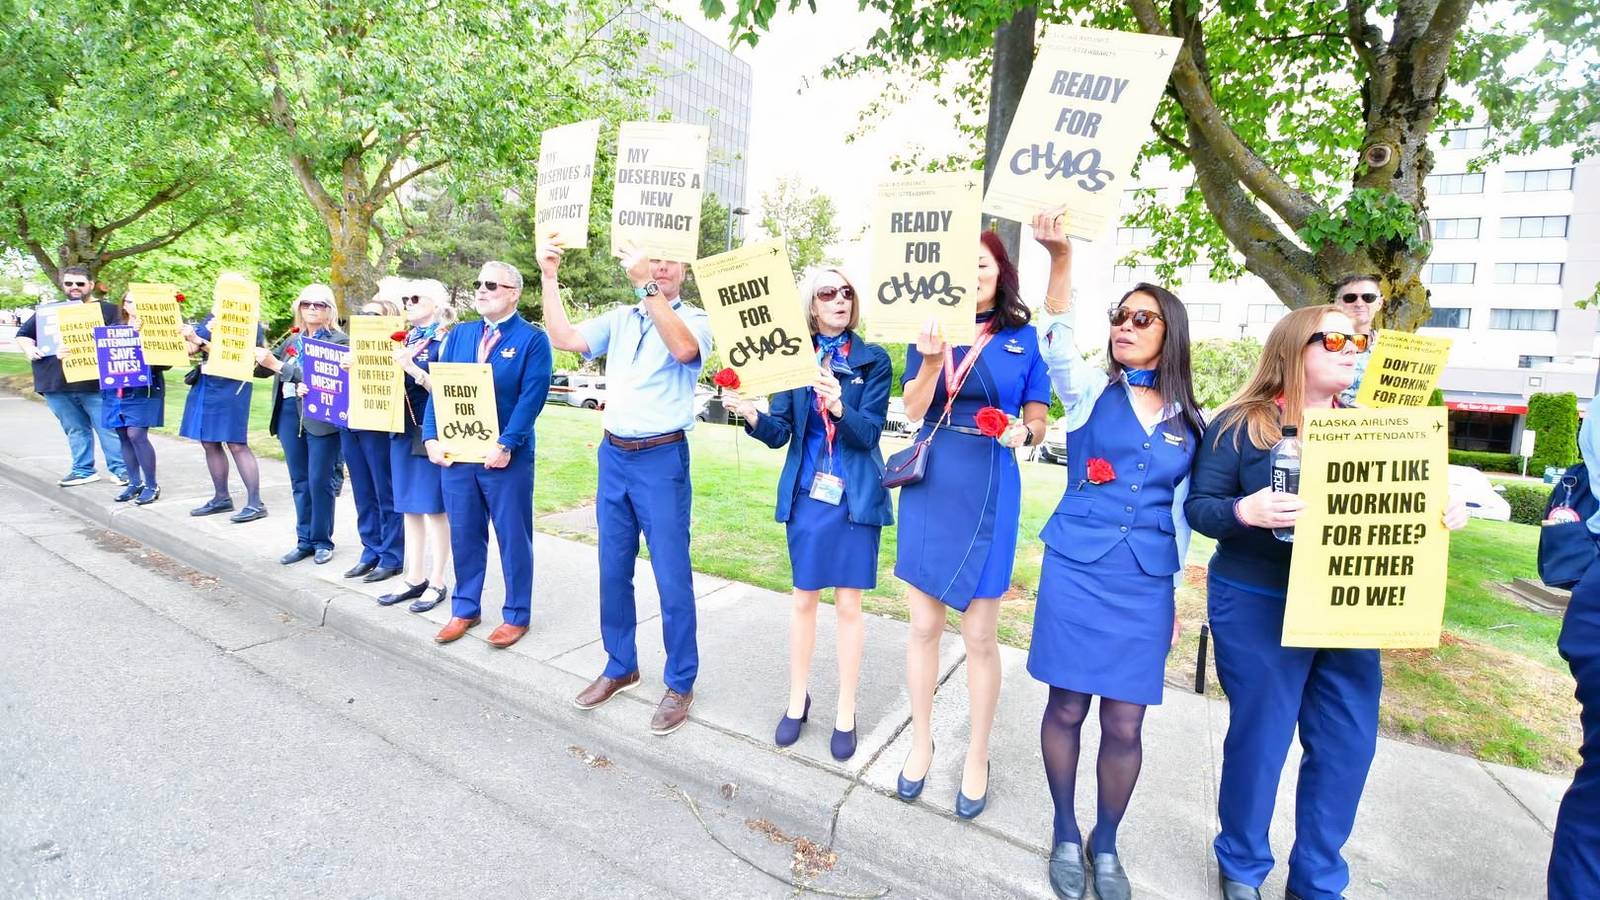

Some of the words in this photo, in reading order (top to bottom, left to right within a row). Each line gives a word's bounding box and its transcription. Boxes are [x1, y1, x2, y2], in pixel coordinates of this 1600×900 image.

[1049, 70, 1129, 103] READY
[1055, 108, 1102, 138] FOR
[545, 152, 557, 164] MY
[628, 148, 648, 163] MY
[539, 165, 580, 186] DESERVES
[584, 164, 590, 178] A
[1010, 142, 1115, 192] CHAOS
[618, 169, 686, 188] DESERVES
[691, 174, 700, 189] A
[550, 186, 569, 200] NEW
[640, 190, 672, 207] NEW
[538, 204, 583, 224] CONTRACT
[618, 210, 692, 232] CONTRACT
[891, 210, 952, 233] READY
[905, 242, 941, 263] FOR
[718, 276, 769, 306] READY
[878, 271, 966, 306] CHAOS
[140, 315, 175, 324] STALLING
[739, 305, 772, 328] FOR
[63, 333, 95, 344] STALLIN
[157, 329, 168, 337] PAY
[98, 337, 141, 348] ATTENDANT
[144, 341, 183, 350] APPALLING
[356, 340, 376, 350] DON'T
[377, 341, 393, 351] LIKE
[730, 328, 802, 367] CHAOS
[109, 348, 136, 360] SAVE
[305, 343, 345, 363] CORPORAT
[358, 356, 393, 366] WORKING
[66, 357, 98, 368] APPALL
[108, 360, 141, 373] LIVES!
[314, 360, 339, 377] GREED
[1383, 358, 1418, 373] DON'T
[1419, 363, 1437, 375] LIKE
[311, 374, 343, 392] DOESN'T
[358, 370, 371, 379] FOR
[372, 371, 394, 380] FREE?
[1380, 374, 1429, 391] WORKING
[362, 385, 391, 395] NEITHER
[443, 385, 477, 398] READY
[1373, 390, 1397, 403] FOR
[1398, 394, 1424, 406] FREE?
[320, 392, 334, 406] FLY
[364, 399, 374, 409] DO
[376, 400, 390, 410] WE!
[455, 403, 475, 415] FOR
[443, 420, 492, 440] CHAOS
[1310, 419, 1356, 427] ALASKA
[1361, 418, 1409, 427] AIRLINES
[1309, 433, 1350, 441] FLIGHT
[1354, 431, 1427, 441] ATTENDANTS
[1327, 461, 1386, 483] DON'T
[1392, 460, 1429, 482] LIKE
[1327, 492, 1426, 514] WORKING
[1322, 525, 1361, 545] FOR
[1367, 524, 1426, 545] FREE?
[1328, 556, 1414, 576] NEITHER
[1330, 586, 1360, 606] DO
[1366, 586, 1406, 606] WE!
